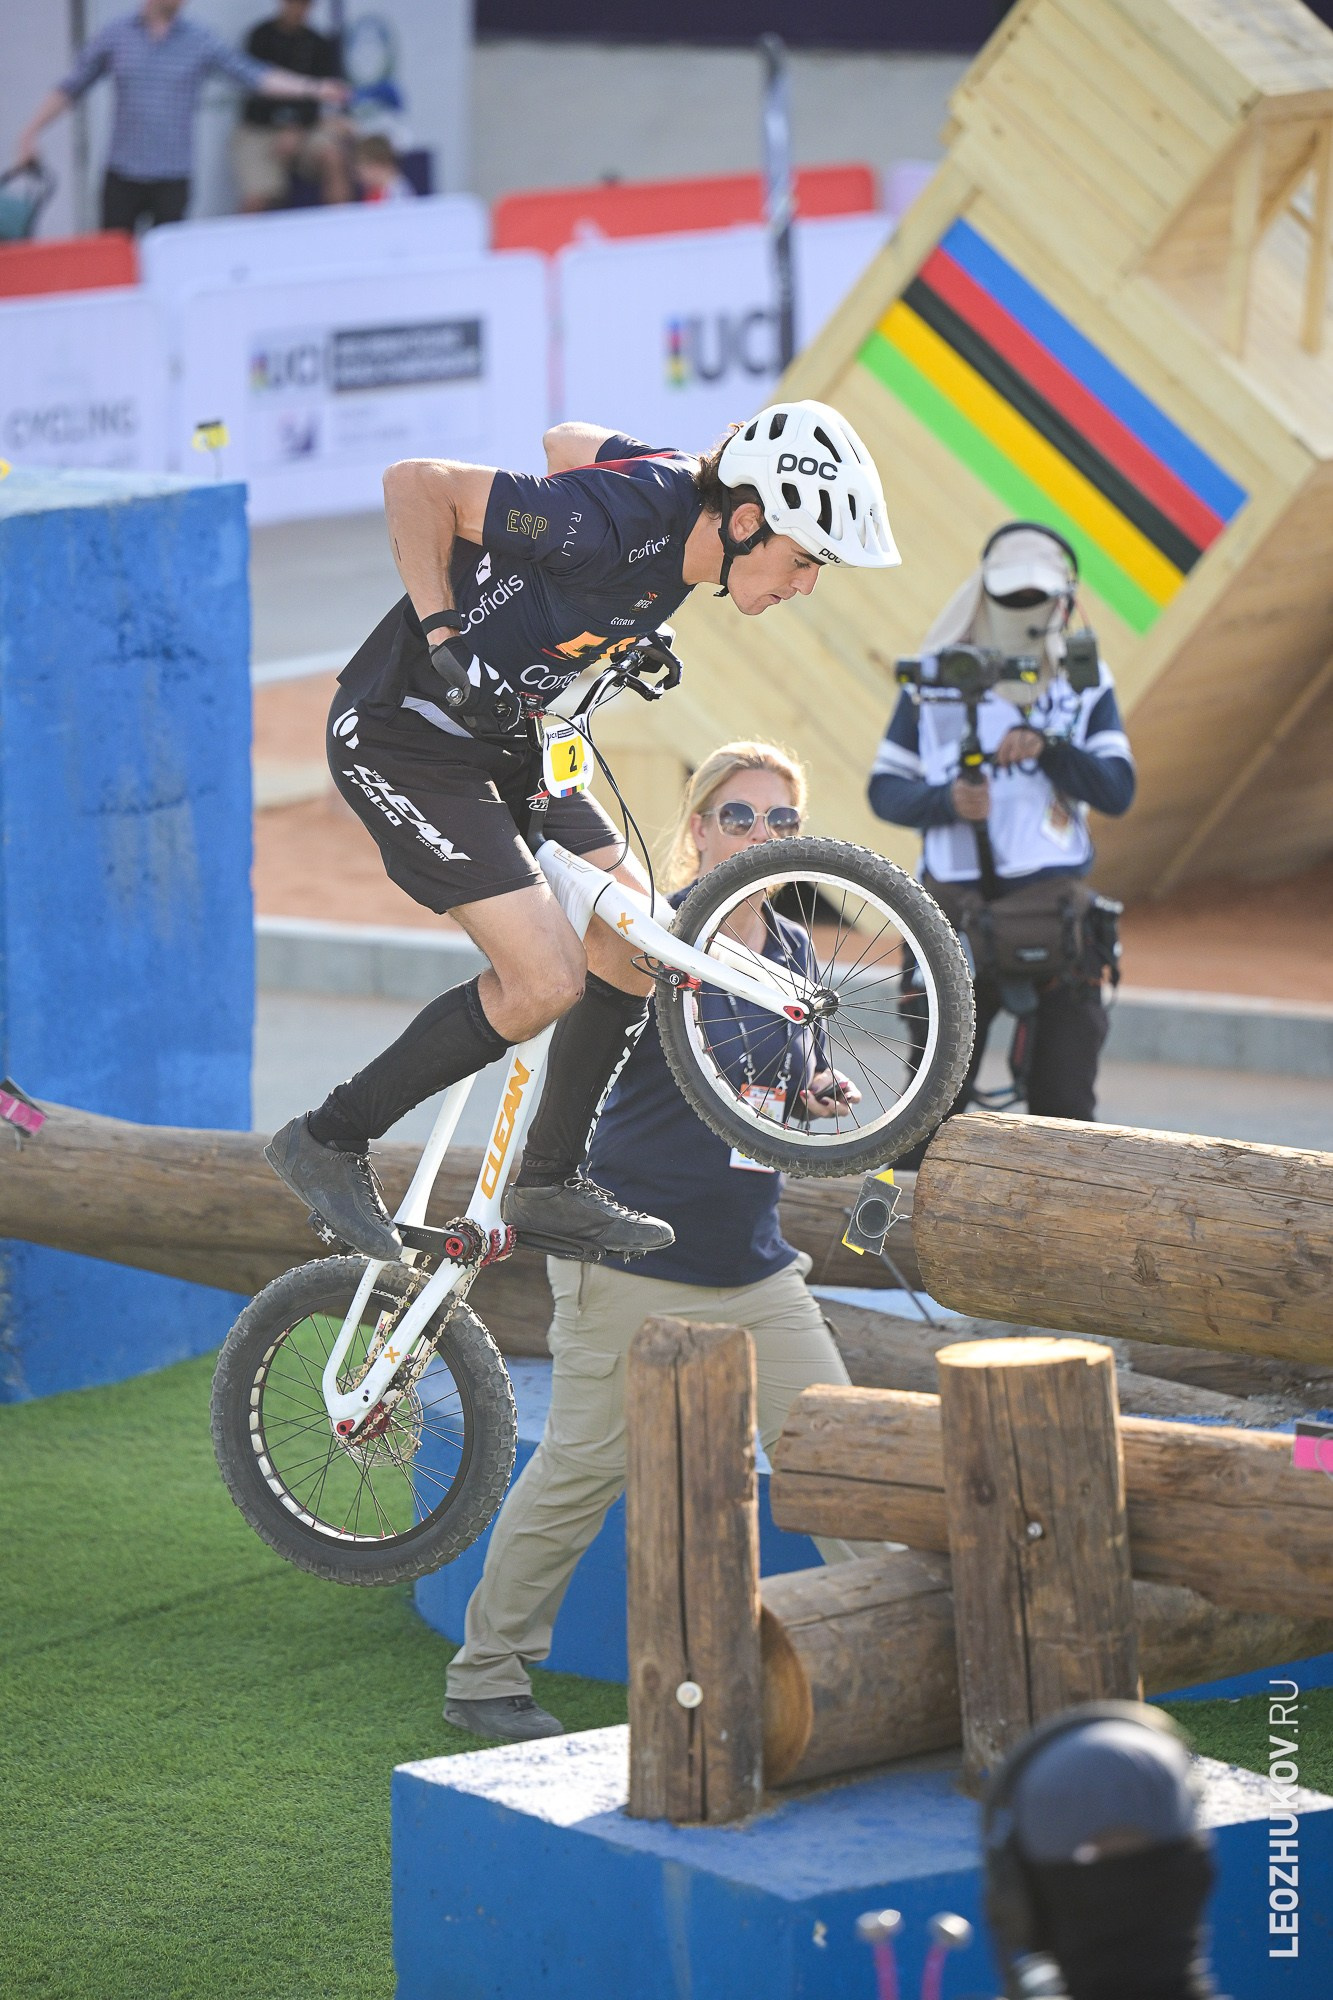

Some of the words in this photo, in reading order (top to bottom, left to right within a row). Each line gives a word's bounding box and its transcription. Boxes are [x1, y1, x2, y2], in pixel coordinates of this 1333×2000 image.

[506, 509, 547, 540] ESP
[569, 745, 577, 773] 2
[416, 835, 450, 862] FACTORY
[480, 1057, 531, 1201] CLEAN
